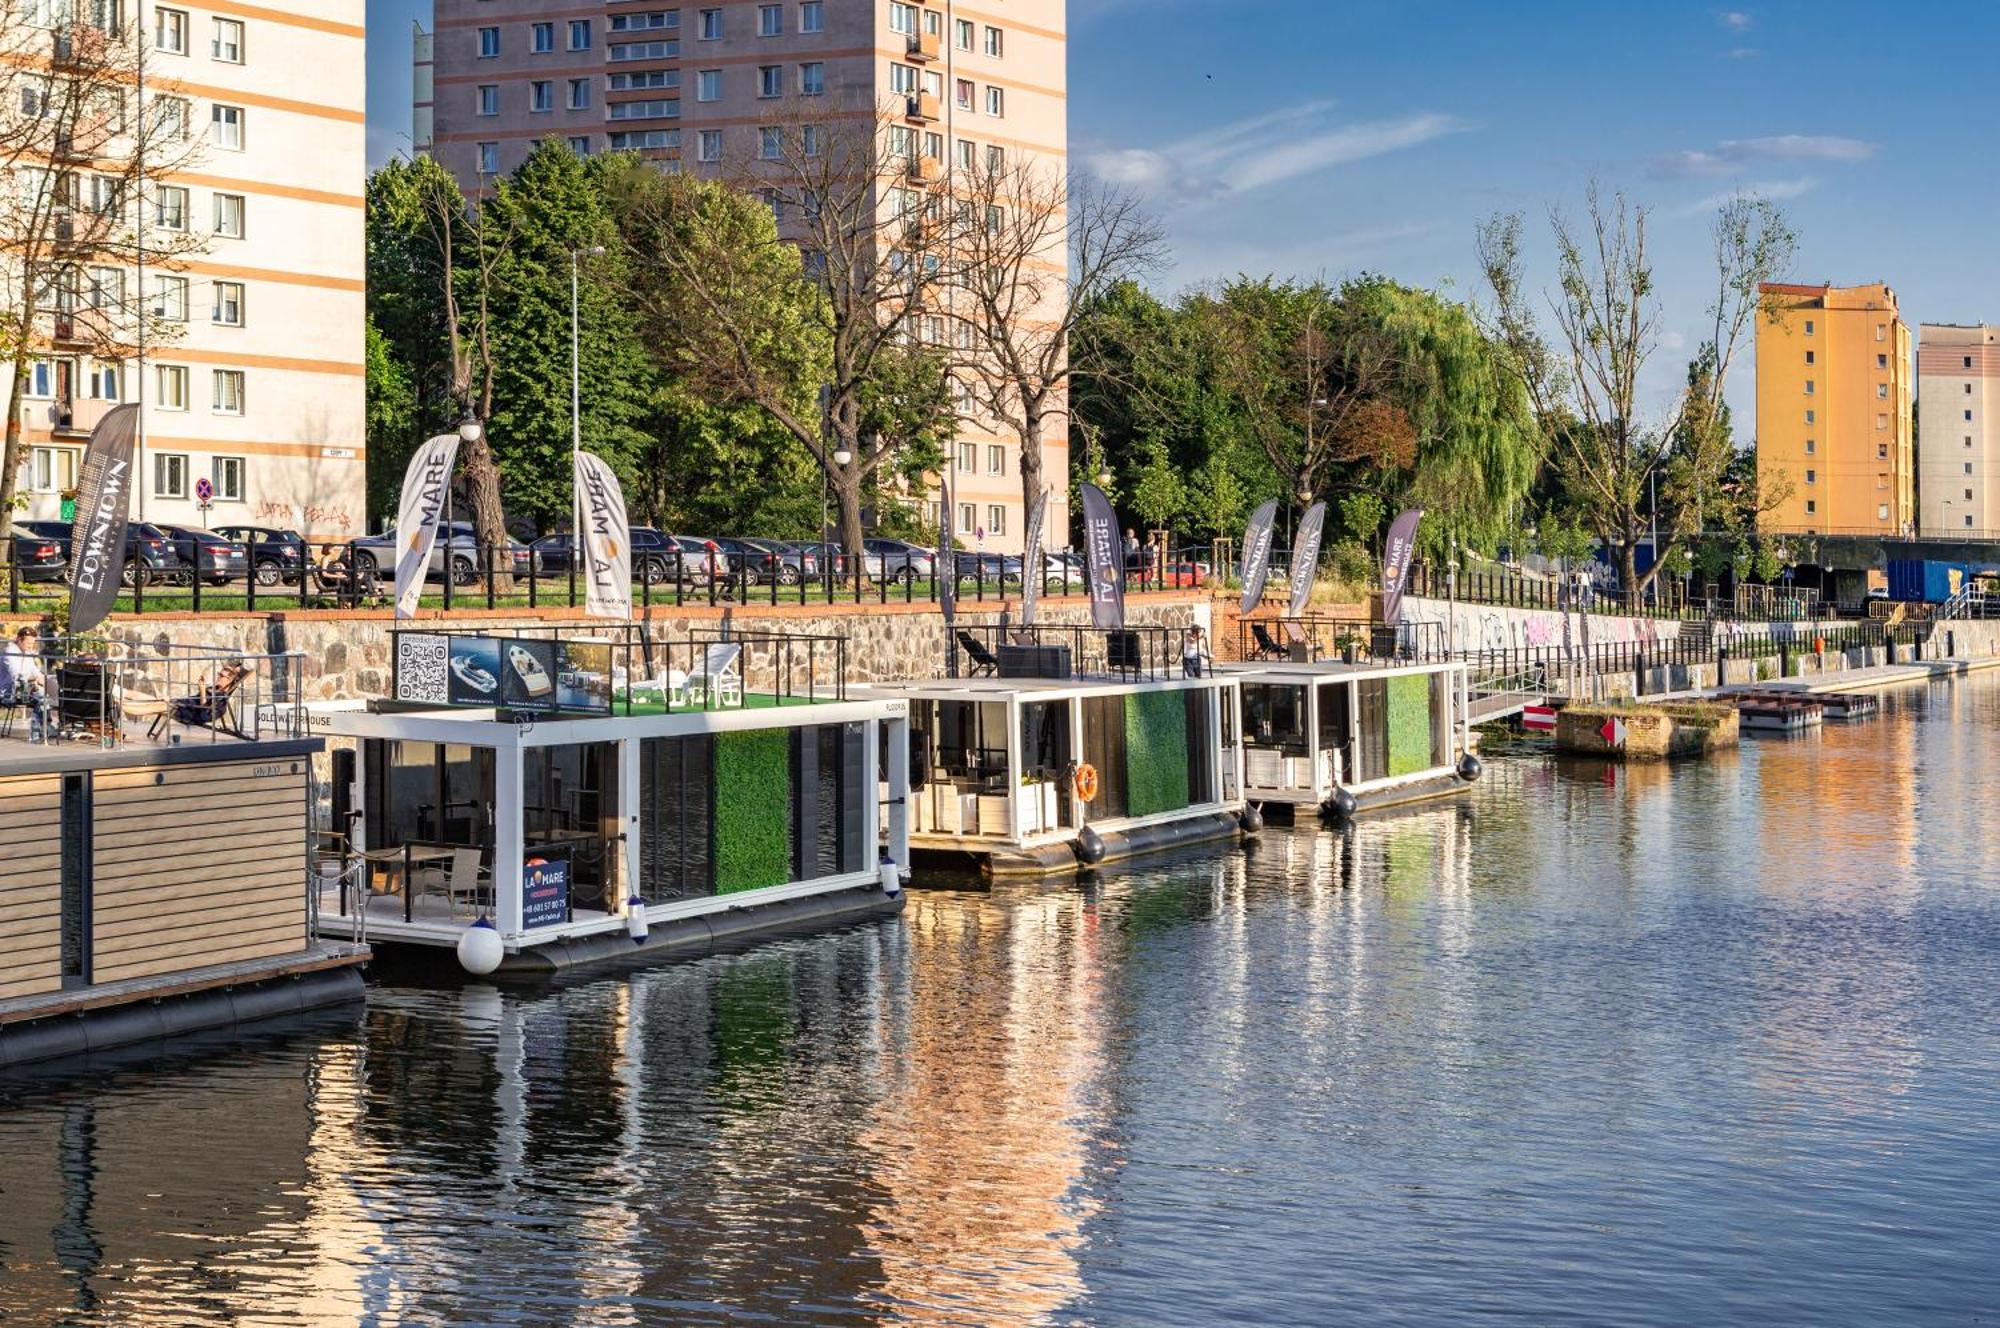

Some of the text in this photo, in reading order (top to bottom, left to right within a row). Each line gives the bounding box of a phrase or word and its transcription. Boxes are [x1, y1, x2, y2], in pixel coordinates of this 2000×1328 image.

[420, 454, 446, 526] MARE
[78, 458, 128, 591] DOWNTOWN
[1386, 537, 1404, 593] LA MARE
[524, 871, 564, 888] LA MARE
